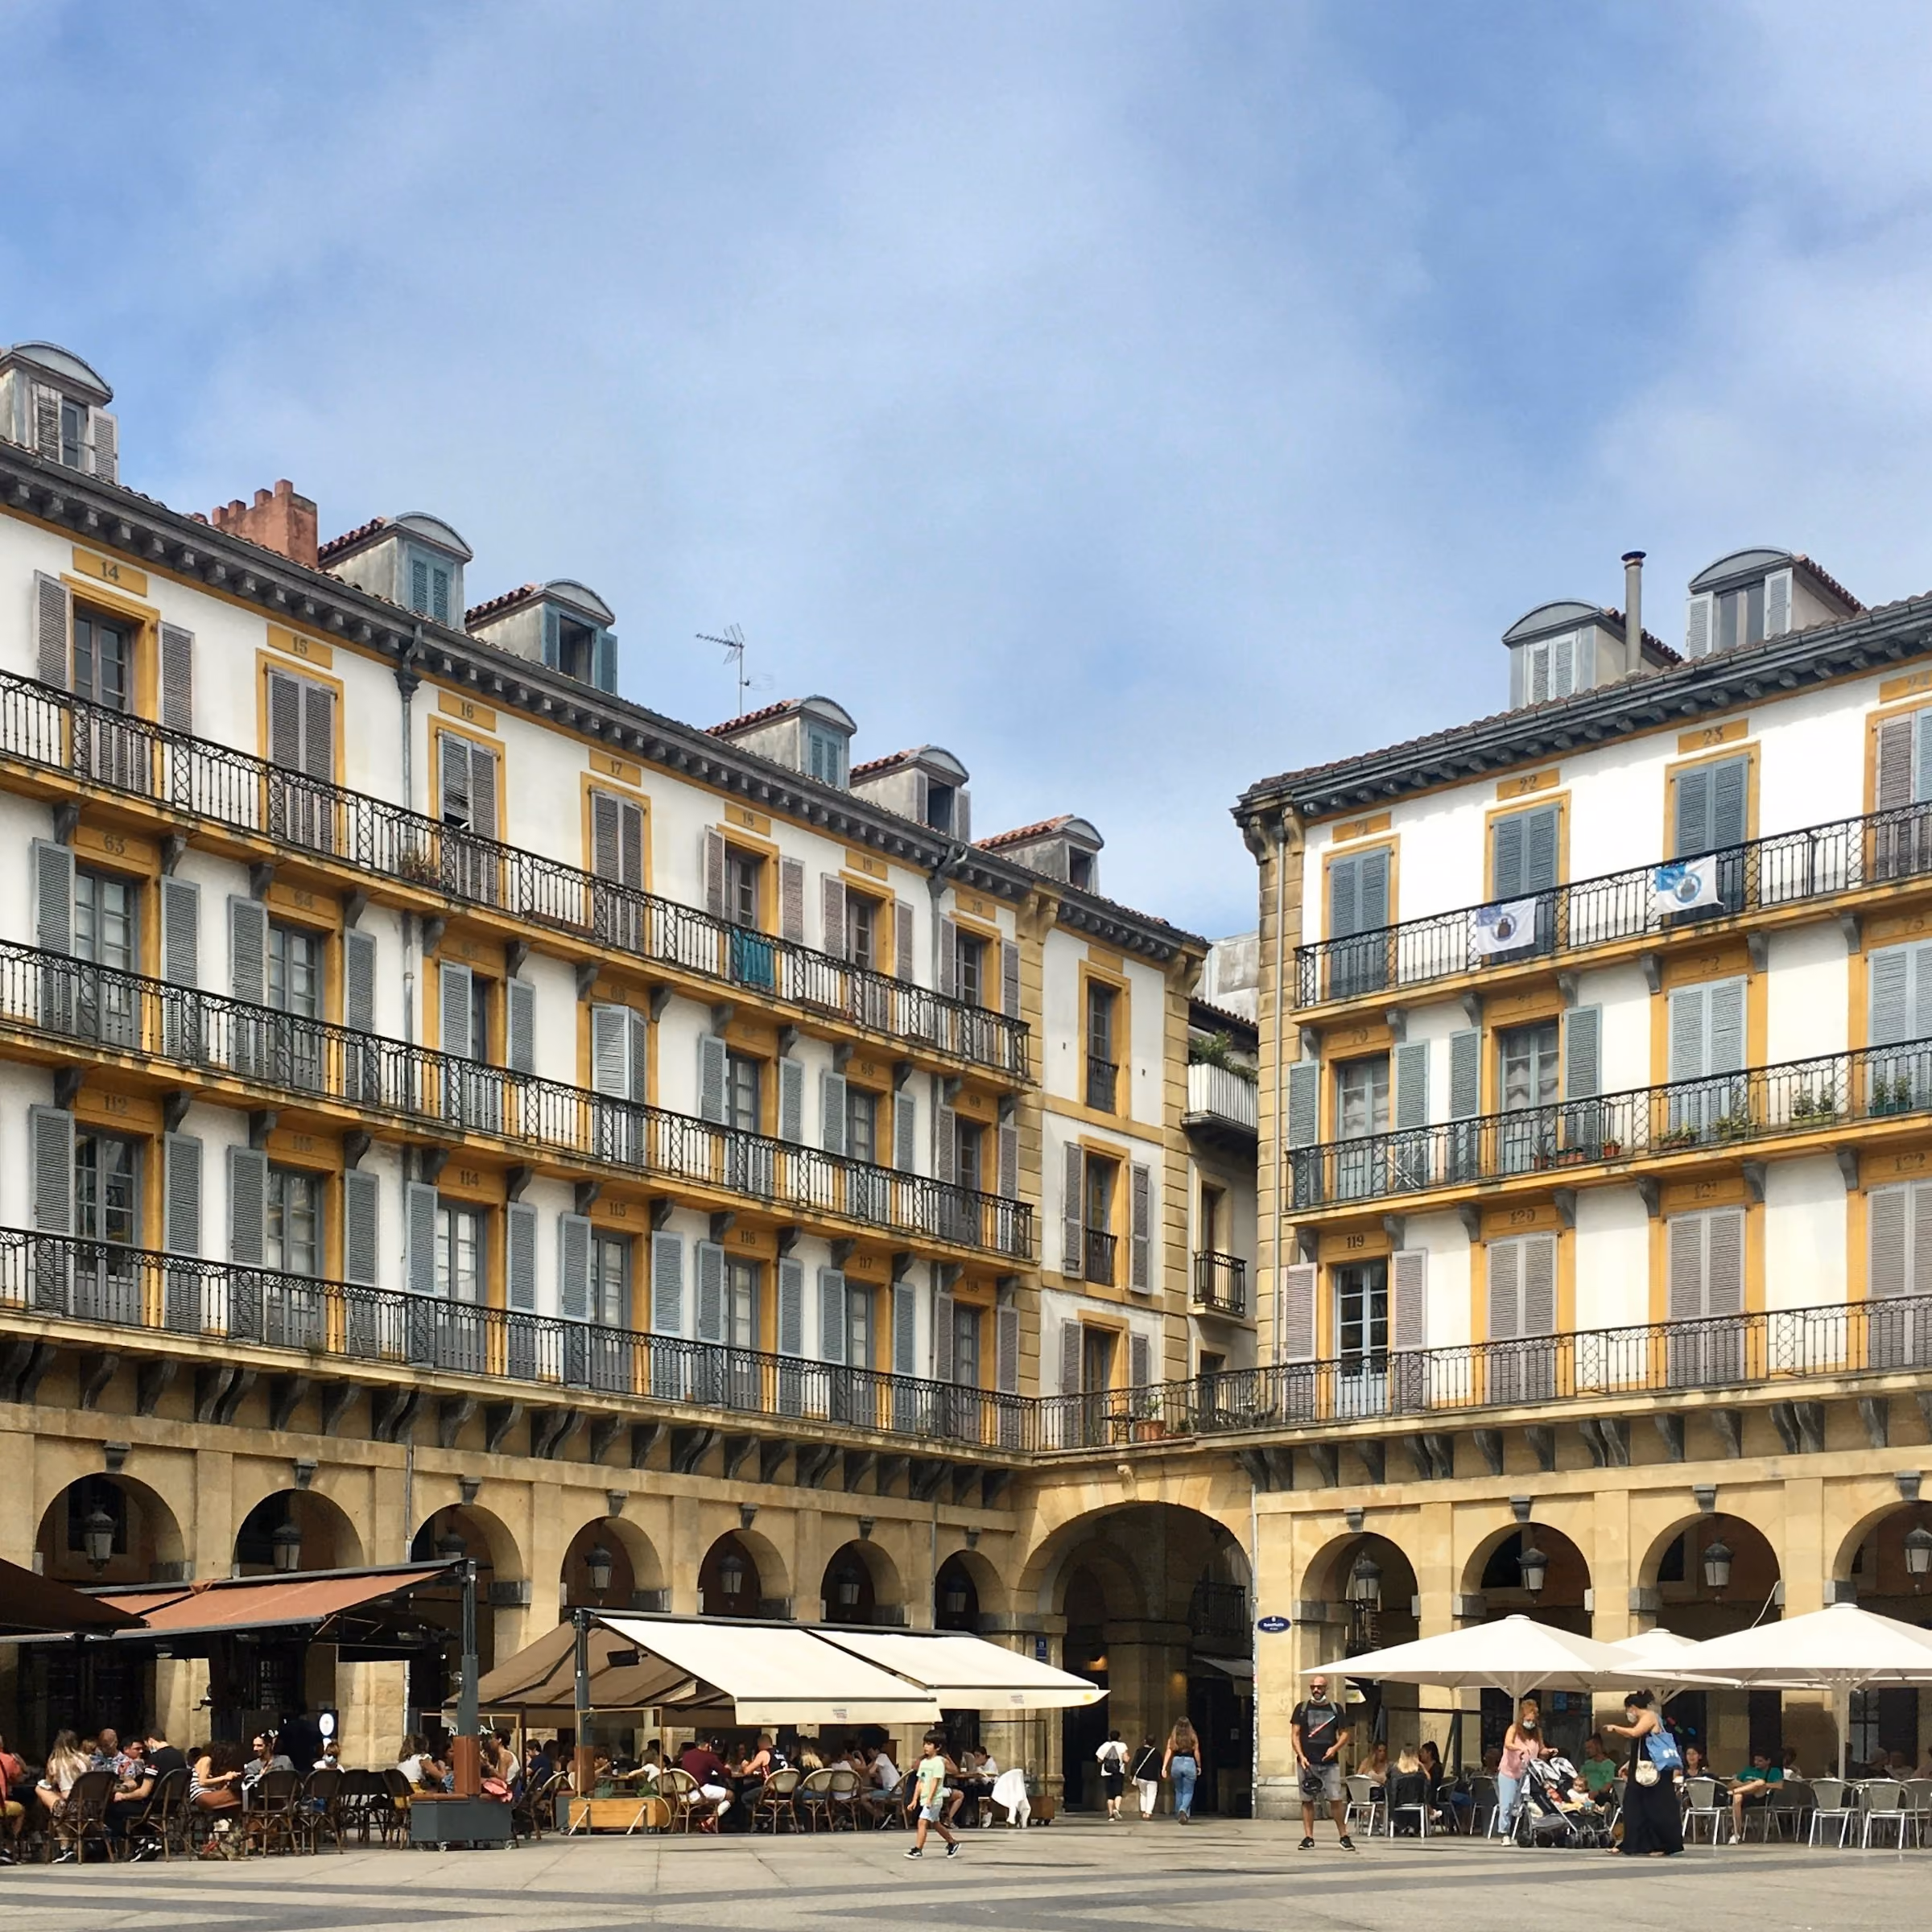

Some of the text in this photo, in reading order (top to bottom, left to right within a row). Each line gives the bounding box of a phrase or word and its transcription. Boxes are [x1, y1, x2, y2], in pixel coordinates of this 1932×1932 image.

[101, 561, 119, 580] 14
[293, 637, 308, 654] 15
[1703, 725, 1724, 745] 23
[611, 760, 622, 774] 17
[1519, 774, 1537, 793] 22
[104, 1094, 127, 1114] 112
[460, 1170, 479, 1187] 114
[609, 1202, 626, 1217] 115
[1510, 1208, 1535, 1224] 120
[741, 1230, 756, 1245] 116
[1347, 1234, 1364, 1249] 119
[859, 1256, 873, 1269] 117
